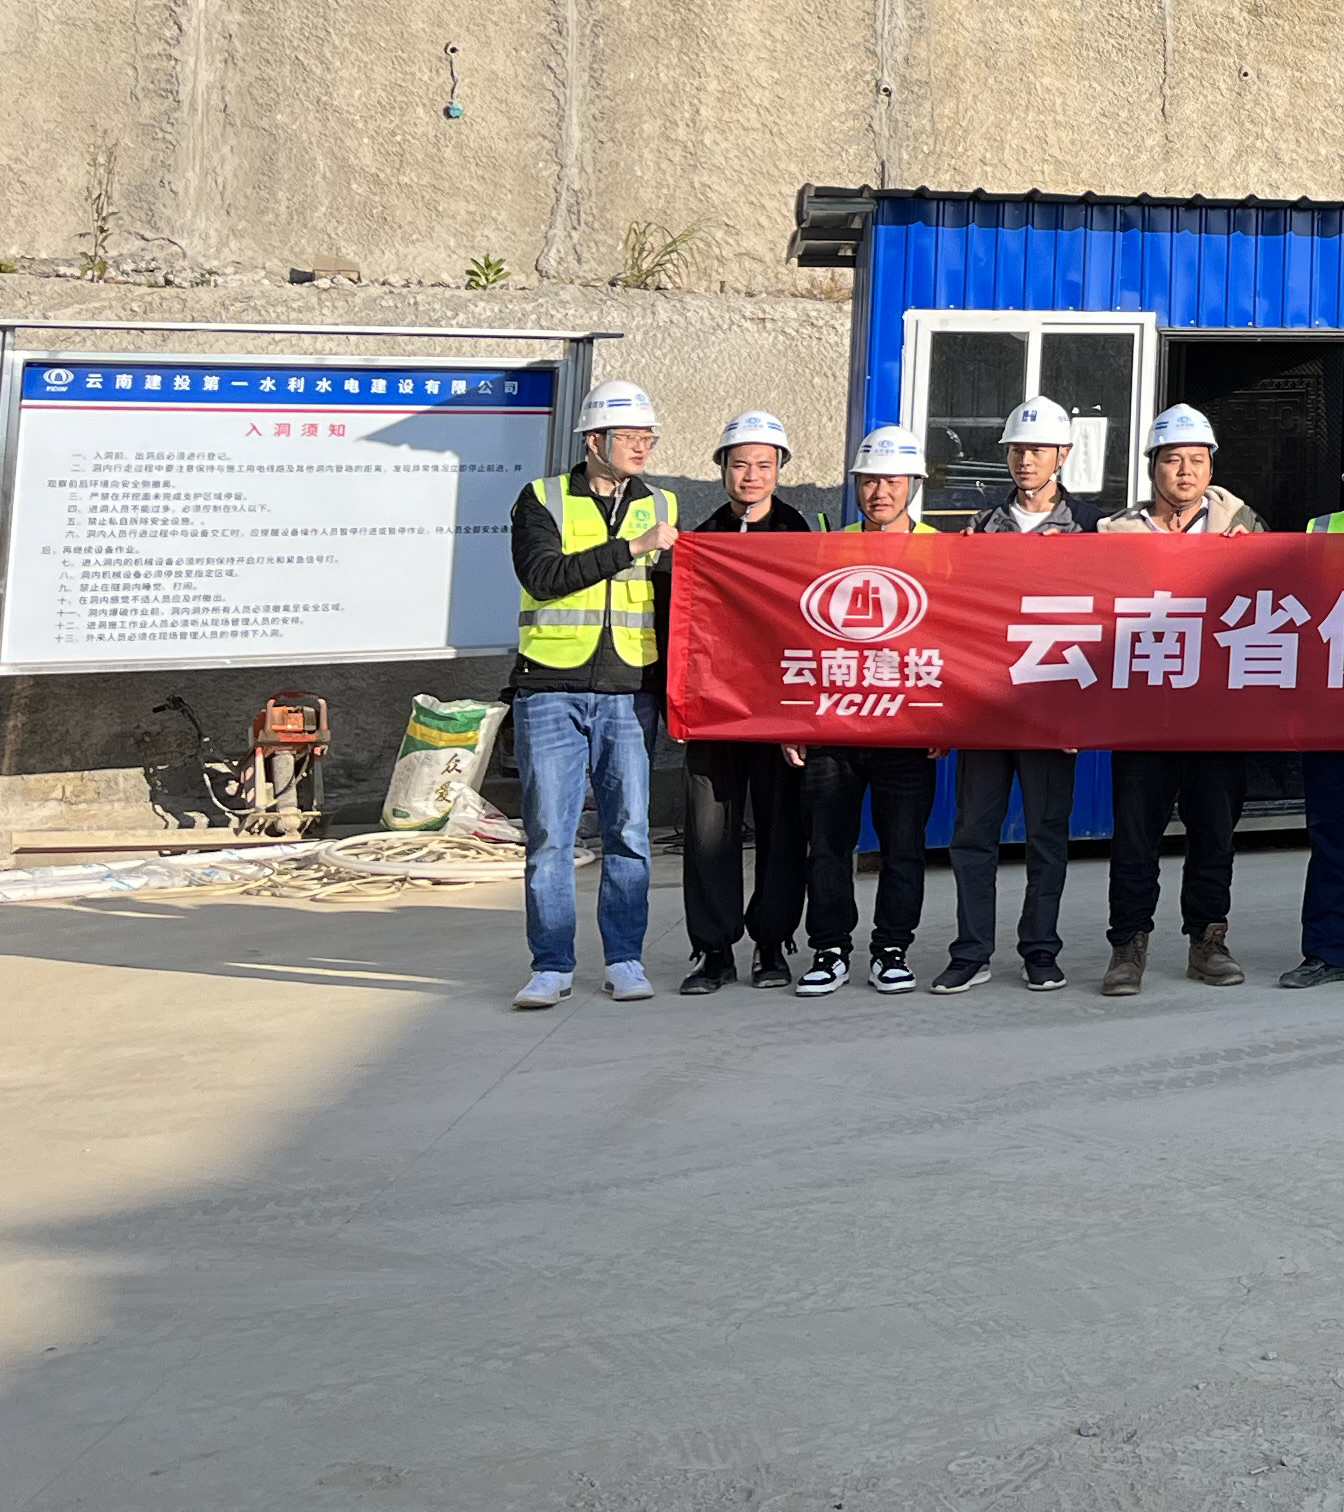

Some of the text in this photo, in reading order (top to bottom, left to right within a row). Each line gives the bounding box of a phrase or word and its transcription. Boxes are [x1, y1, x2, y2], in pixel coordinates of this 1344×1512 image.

[85, 373, 519, 396] 云南建投第一水利水电建设有限公司
[245, 423, 346, 437] 入洞须知
[780, 648, 943, 688] 云南建投
[815, 693, 902, 717] YCIH
